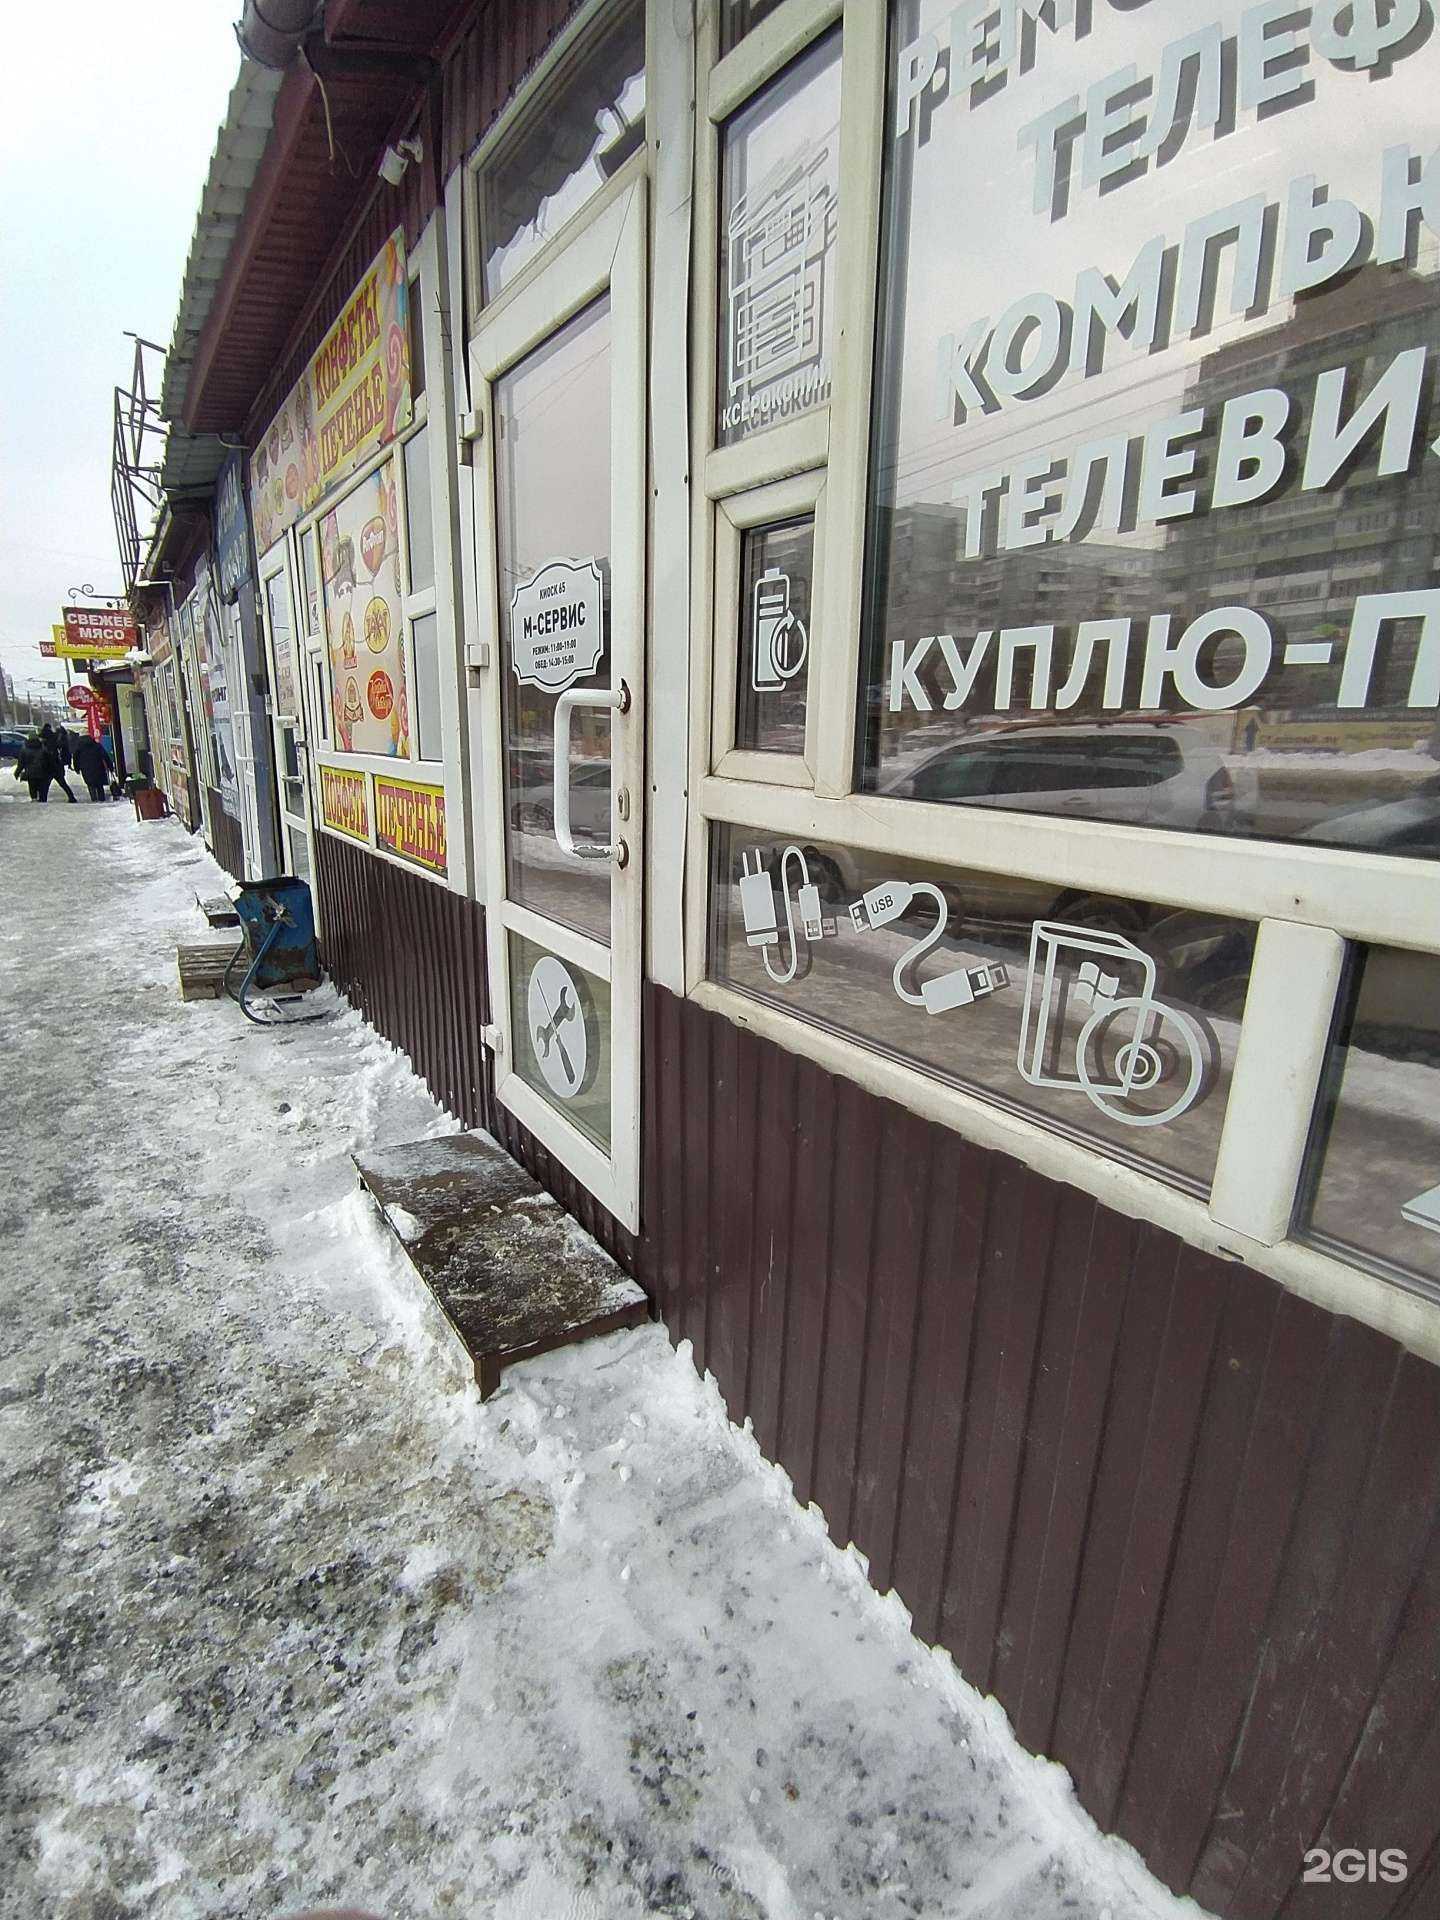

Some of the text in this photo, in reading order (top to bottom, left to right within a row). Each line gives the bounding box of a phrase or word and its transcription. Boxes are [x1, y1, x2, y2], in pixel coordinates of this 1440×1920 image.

[315, 273, 380, 410] КОНФЕТЫ
[321, 362, 384, 474] ПЕЧЕНЬЕ
[951, 346, 1440, 558] ТЕЛЕВИ
[540, 582, 566, 600] КИОСК 65
[66, 613, 133, 627] СВЕЖЕЕ
[79, 627, 125, 640] МЯСО
[523, 601, 586, 639] М-СЕРВИС
[377, 783, 447, 866] ПЕЧЕНЬЕ
[871, 895, 894, 914] USB
